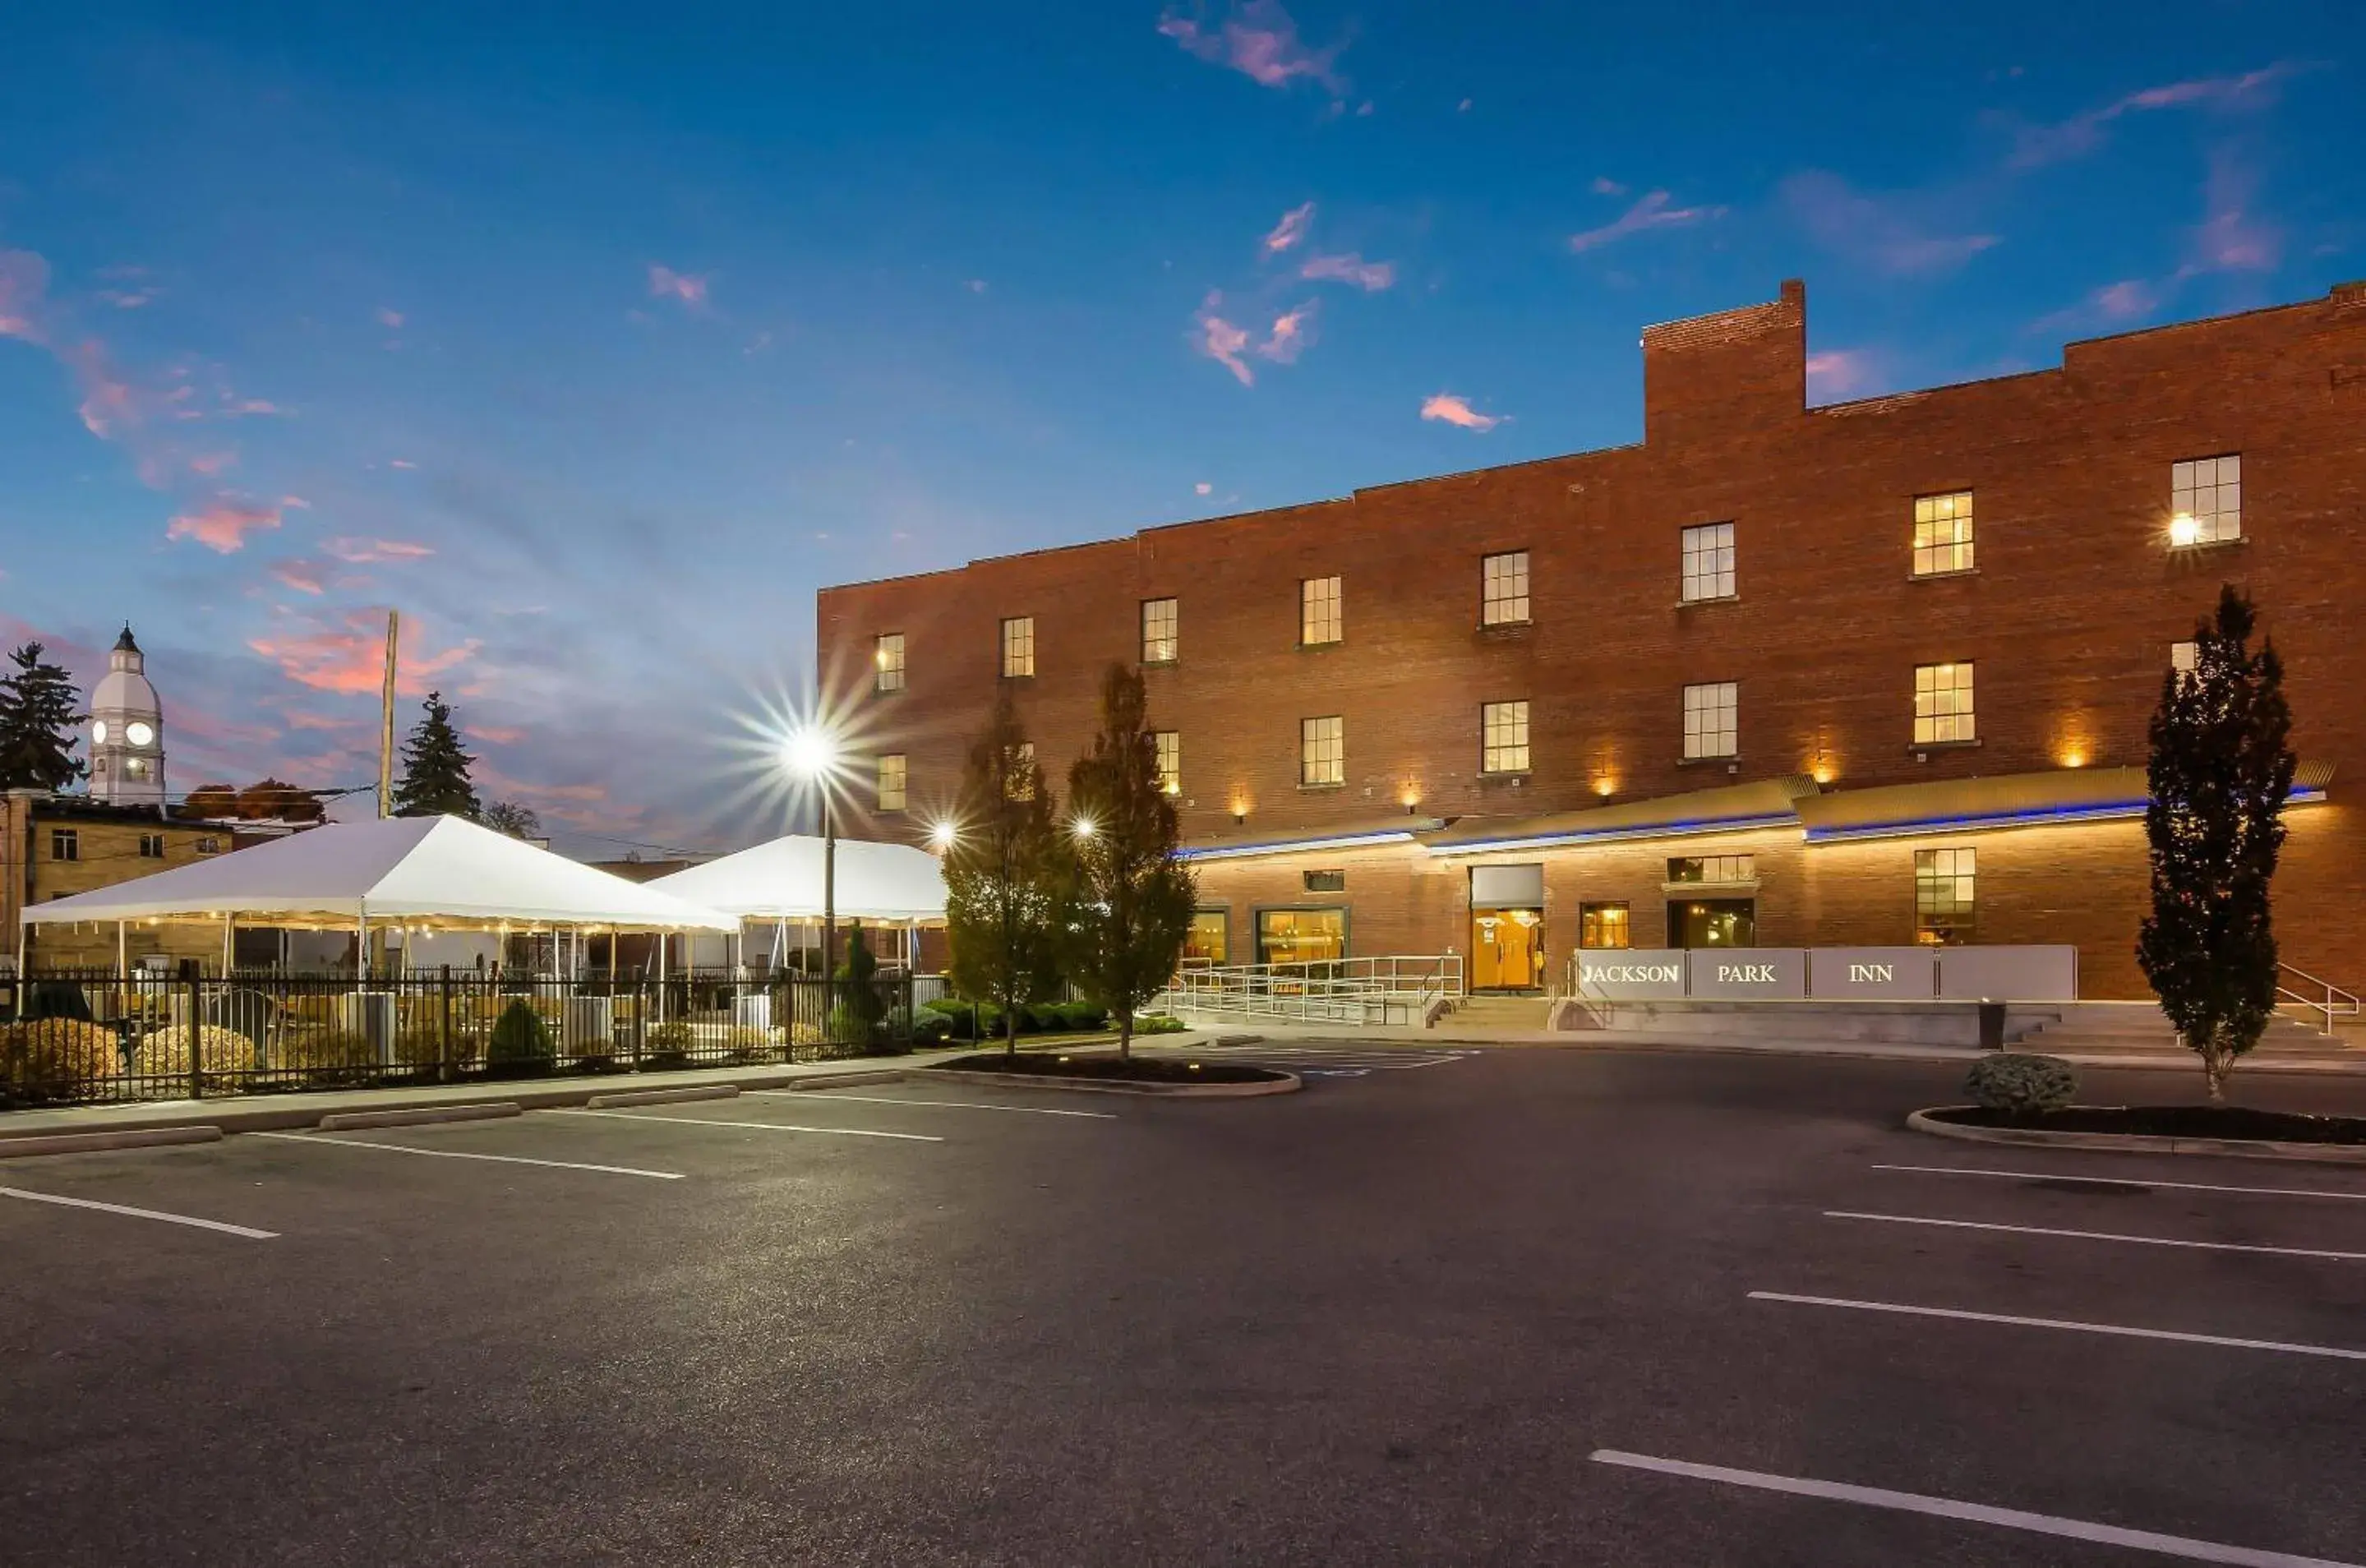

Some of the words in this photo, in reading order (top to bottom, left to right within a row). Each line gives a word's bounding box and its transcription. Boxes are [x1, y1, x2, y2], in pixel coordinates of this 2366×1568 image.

[1583, 965, 1679, 983] JACKSON
[1718, 965, 1777, 982] PARK
[1849, 965, 1893, 982] INN
